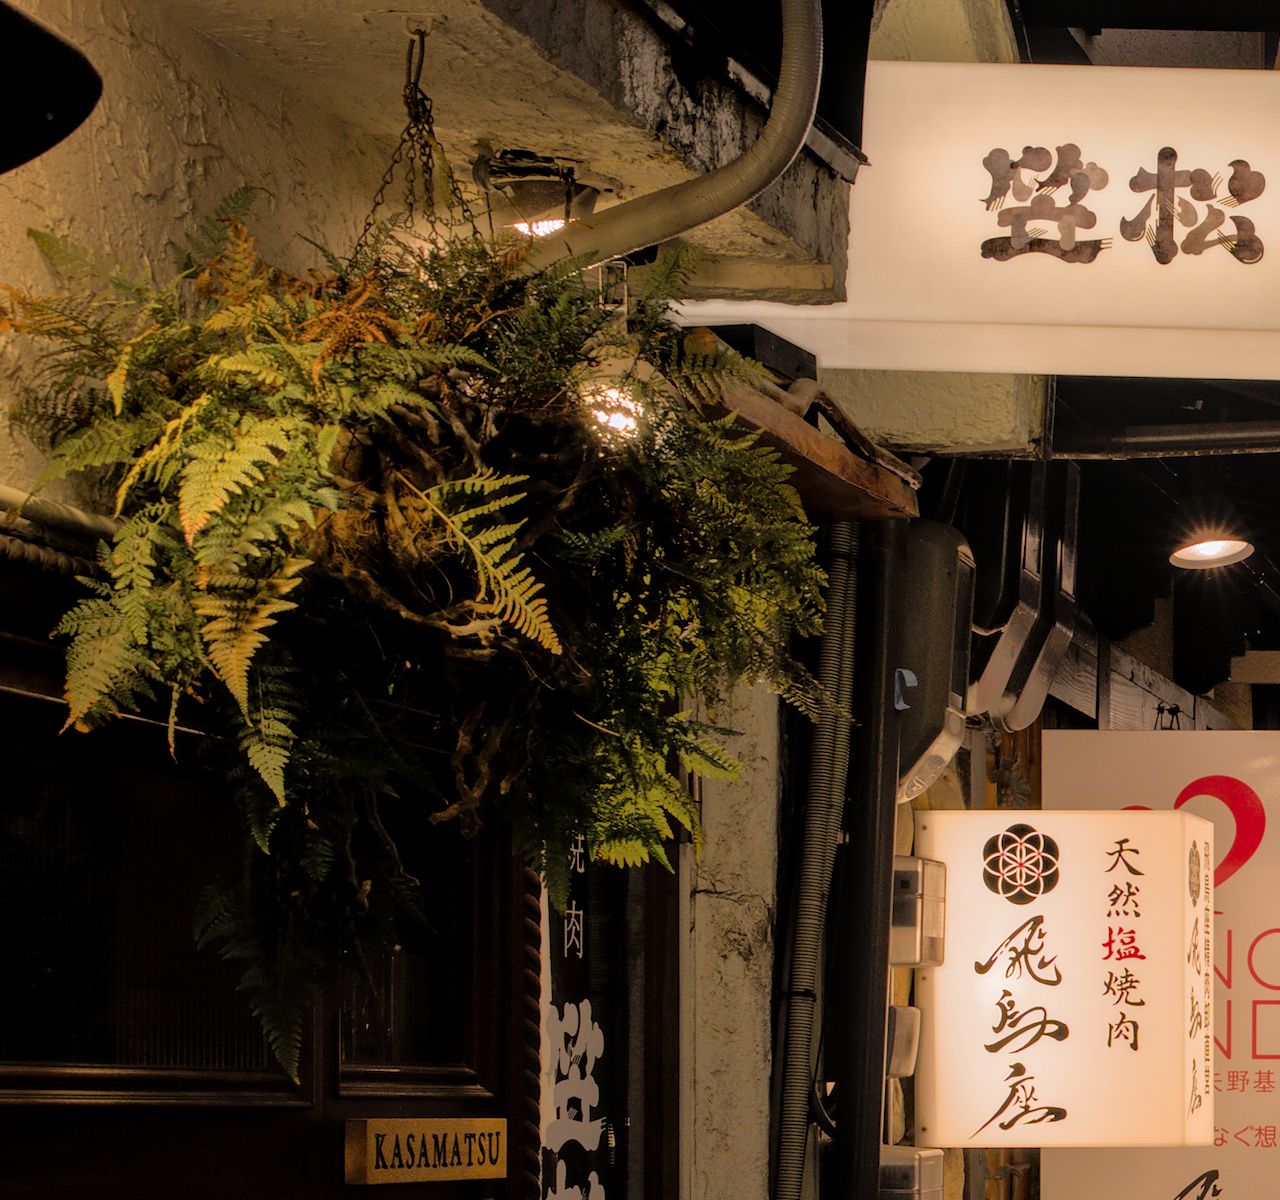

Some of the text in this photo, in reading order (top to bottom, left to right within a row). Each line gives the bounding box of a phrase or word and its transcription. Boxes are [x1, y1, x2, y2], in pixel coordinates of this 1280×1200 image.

[1101, 838, 1146, 1051] 天然塩焼肉
[373, 1131, 502, 1170] KASAMATSU
